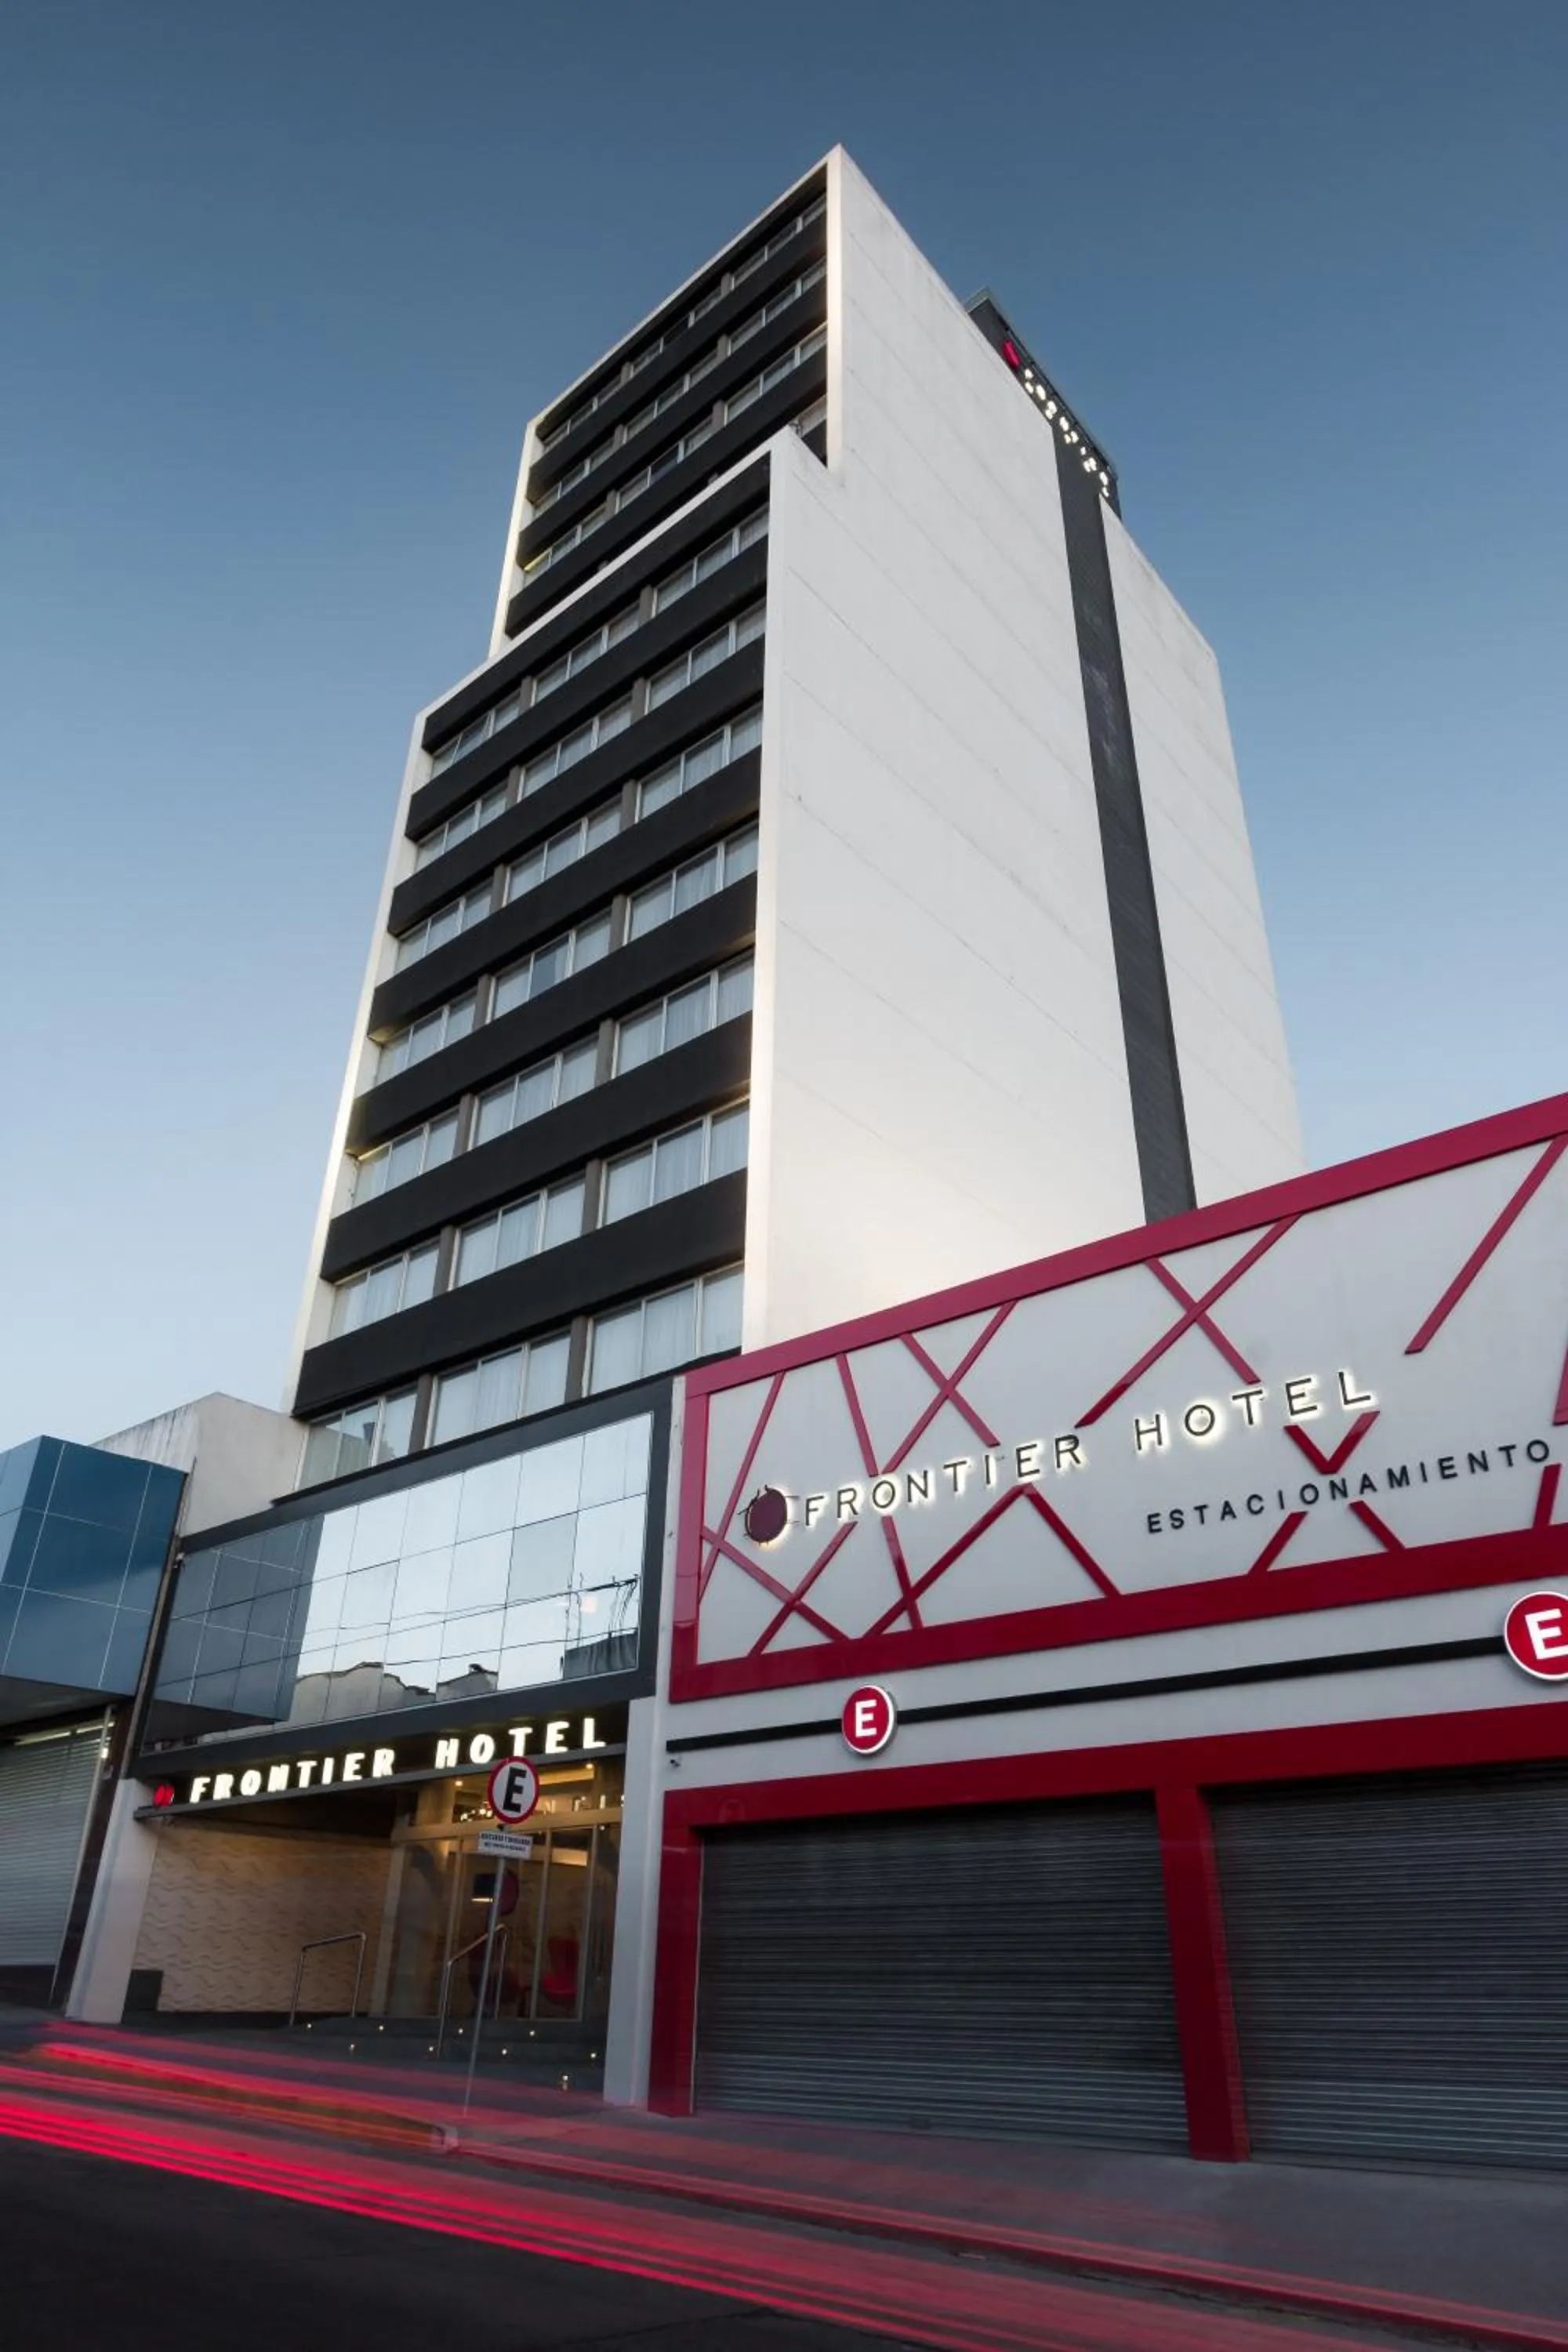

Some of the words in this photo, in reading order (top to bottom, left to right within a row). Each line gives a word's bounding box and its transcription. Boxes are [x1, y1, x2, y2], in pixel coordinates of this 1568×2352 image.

[804, 1433, 1081, 1527] FRONTIER
[1134, 1370, 1371, 1451] HOTEL
[1146, 1439, 1550, 1534] ESTACIONAMIENTO
[1525, 1608, 1568, 1660] E
[855, 1699, 877, 1738] E
[189, 1748, 394, 1804] FRONTIER
[434, 1717, 606, 1769] HOTEL
[503, 1766, 527, 1813] E
